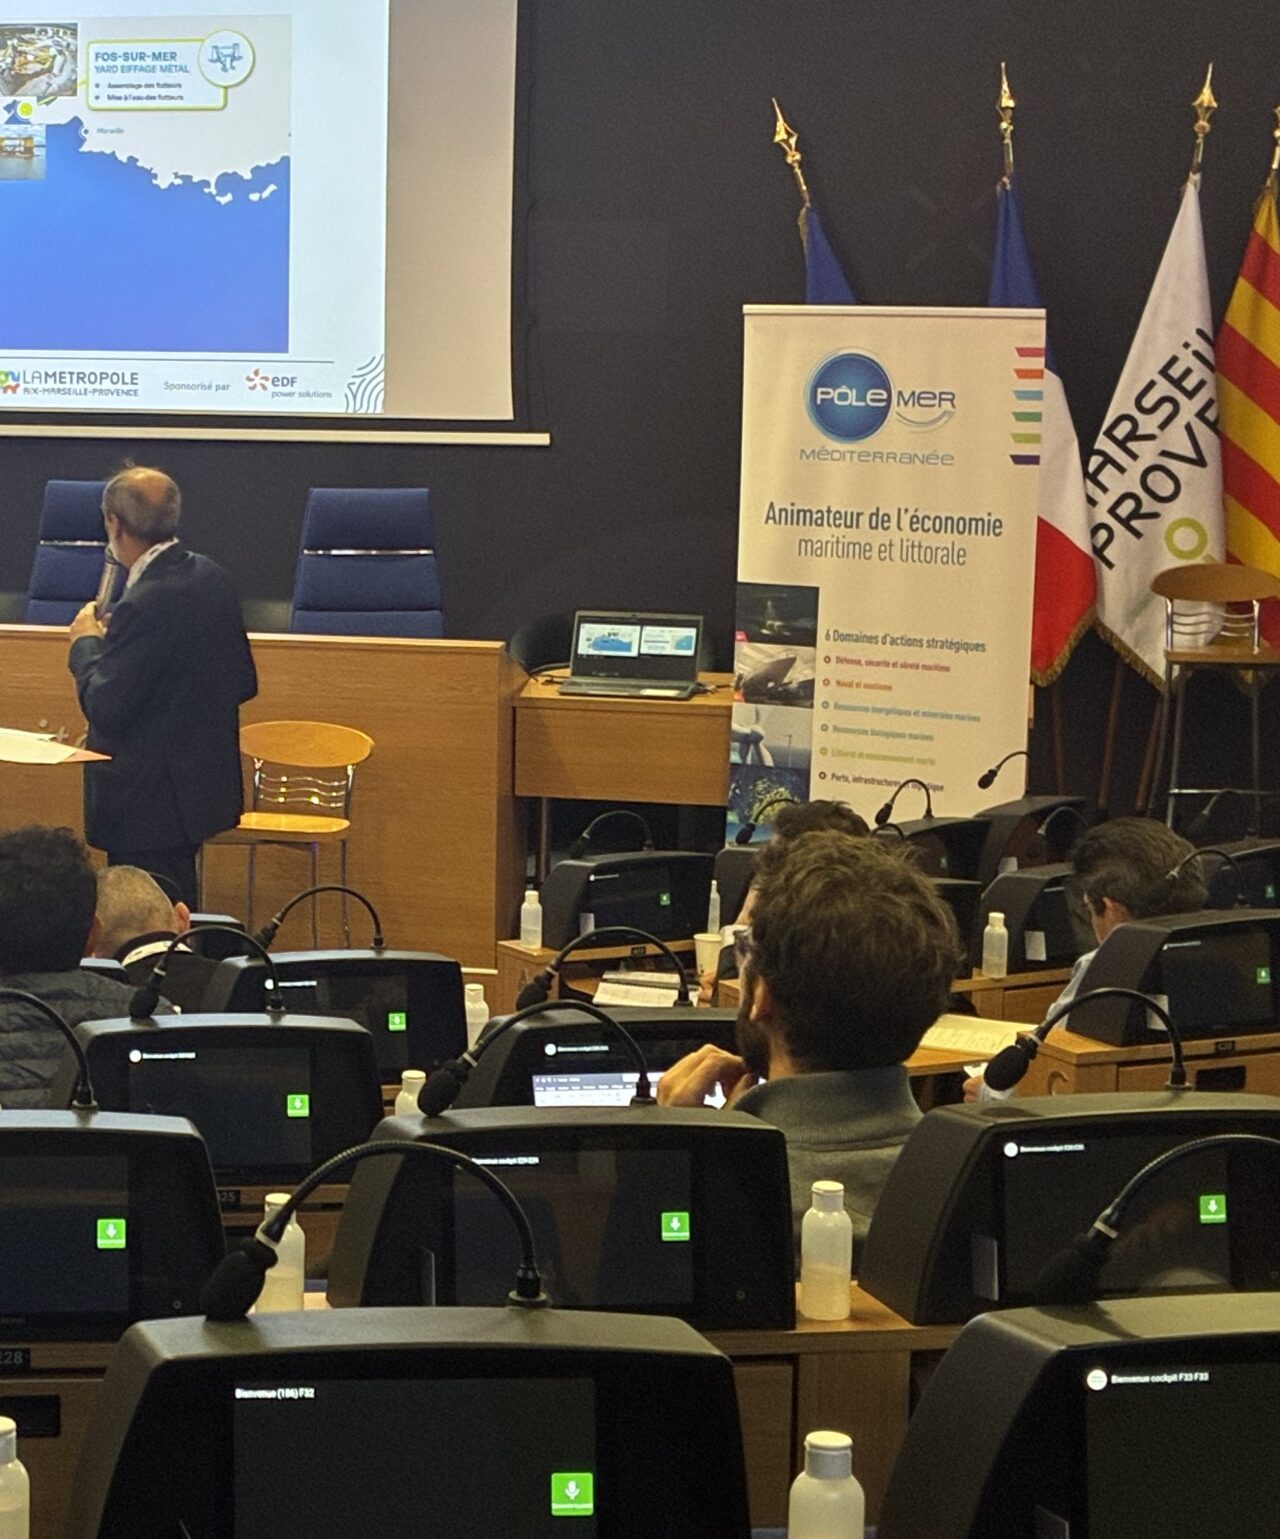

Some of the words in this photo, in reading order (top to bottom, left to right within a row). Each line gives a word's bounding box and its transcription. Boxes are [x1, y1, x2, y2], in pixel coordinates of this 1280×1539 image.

[95, 51, 177, 62] FOS-SUR-MER
[163, 381, 212, 391] Sponsorisé
[215, 383, 230, 392] par
[271, 390, 295, 398] power
[298, 390, 332, 398] solutions
[764, 501, 865, 530] Animateur
[868, 506, 891, 531] de
[896, 507, 1003, 537] l'économie
[797, 534, 872, 561] maritime
[878, 540, 894, 561] et
[900, 538, 967, 566] littorale
[824, 629, 831, 641] 6
[832, 629, 879, 645] Domaines
[881, 634, 924, 649] d'actions
[926, 637, 986, 653] stratégiques
[1111, 1374, 1150, 1384] Bienvenue
[1151, 1374, 1178, 1384] cockpit
[1179, 1372, 1193, 1382] F33
[1194, 1372, 1209, 1381] F33
[235, 1388, 276, 1399] Bienvenue
